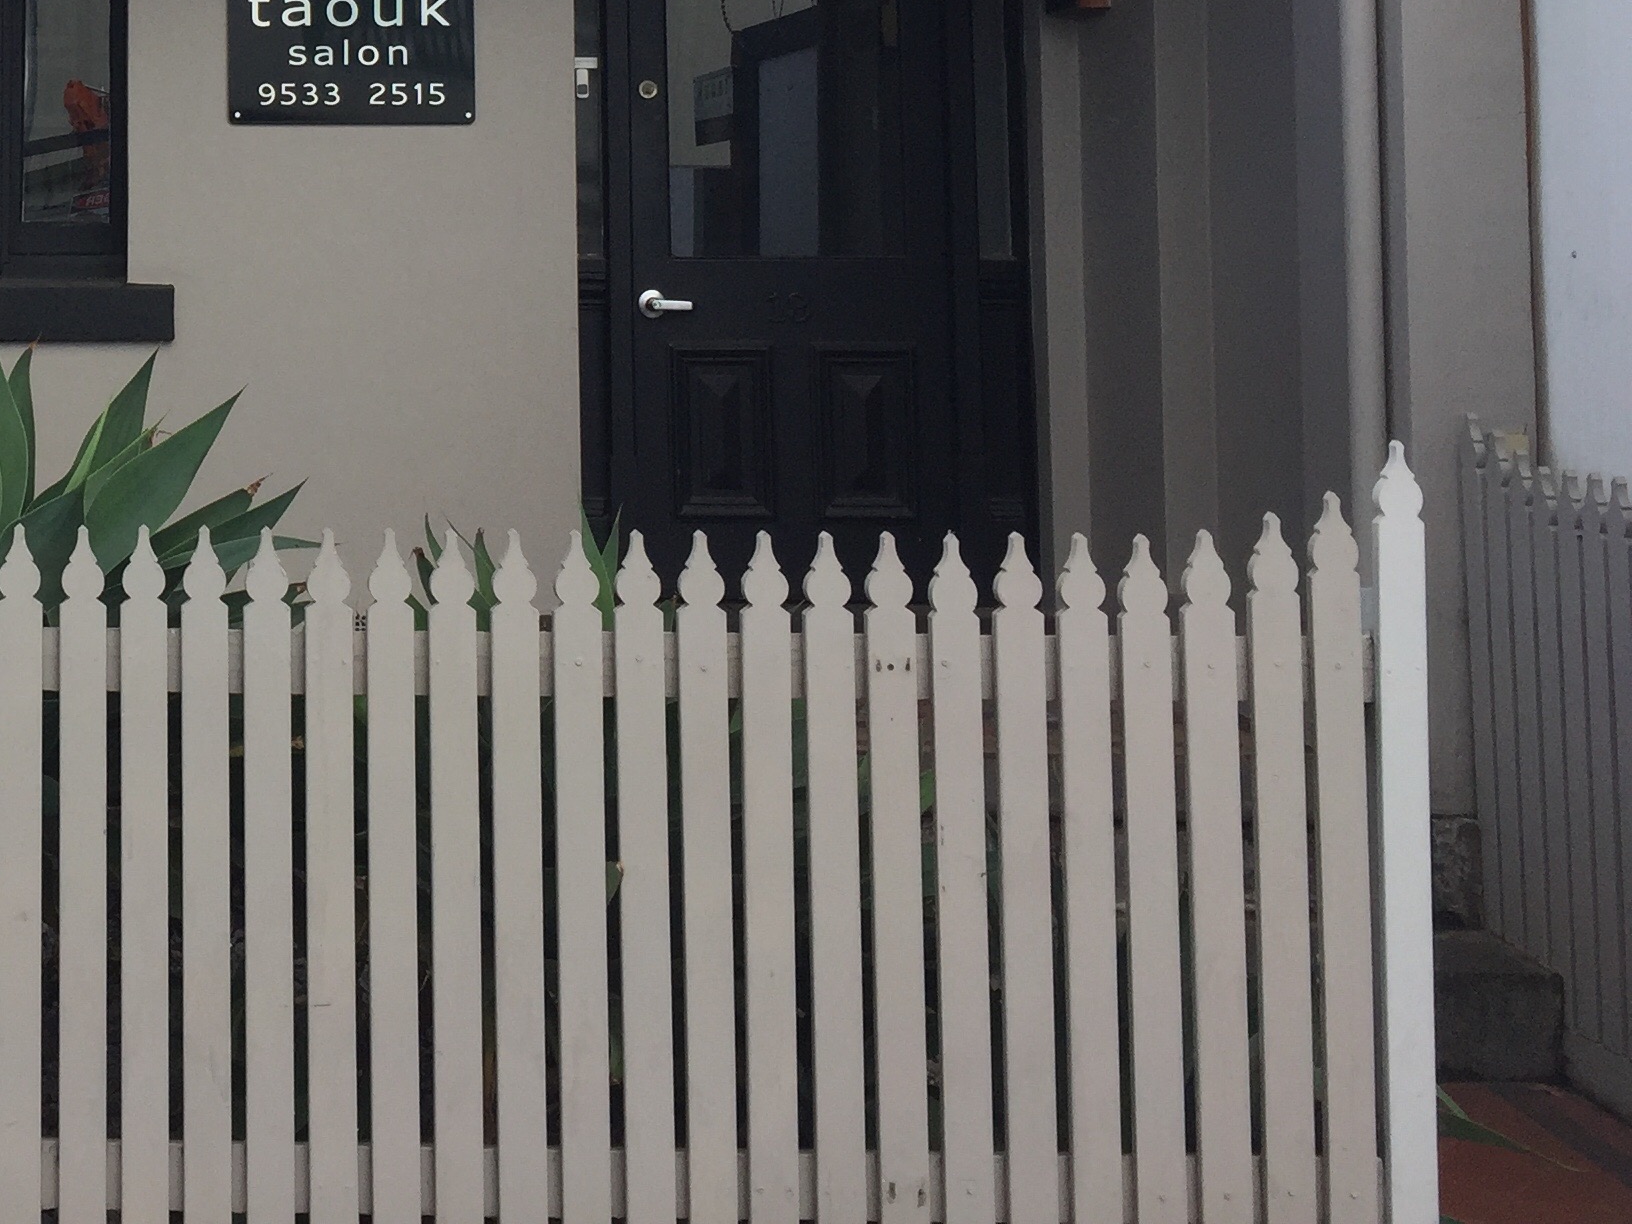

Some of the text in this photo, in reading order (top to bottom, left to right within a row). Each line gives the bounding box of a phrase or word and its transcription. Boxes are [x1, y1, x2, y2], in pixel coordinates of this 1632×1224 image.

[288, 38, 408, 66] salon
[258, 82, 447, 106] 9533 2515
